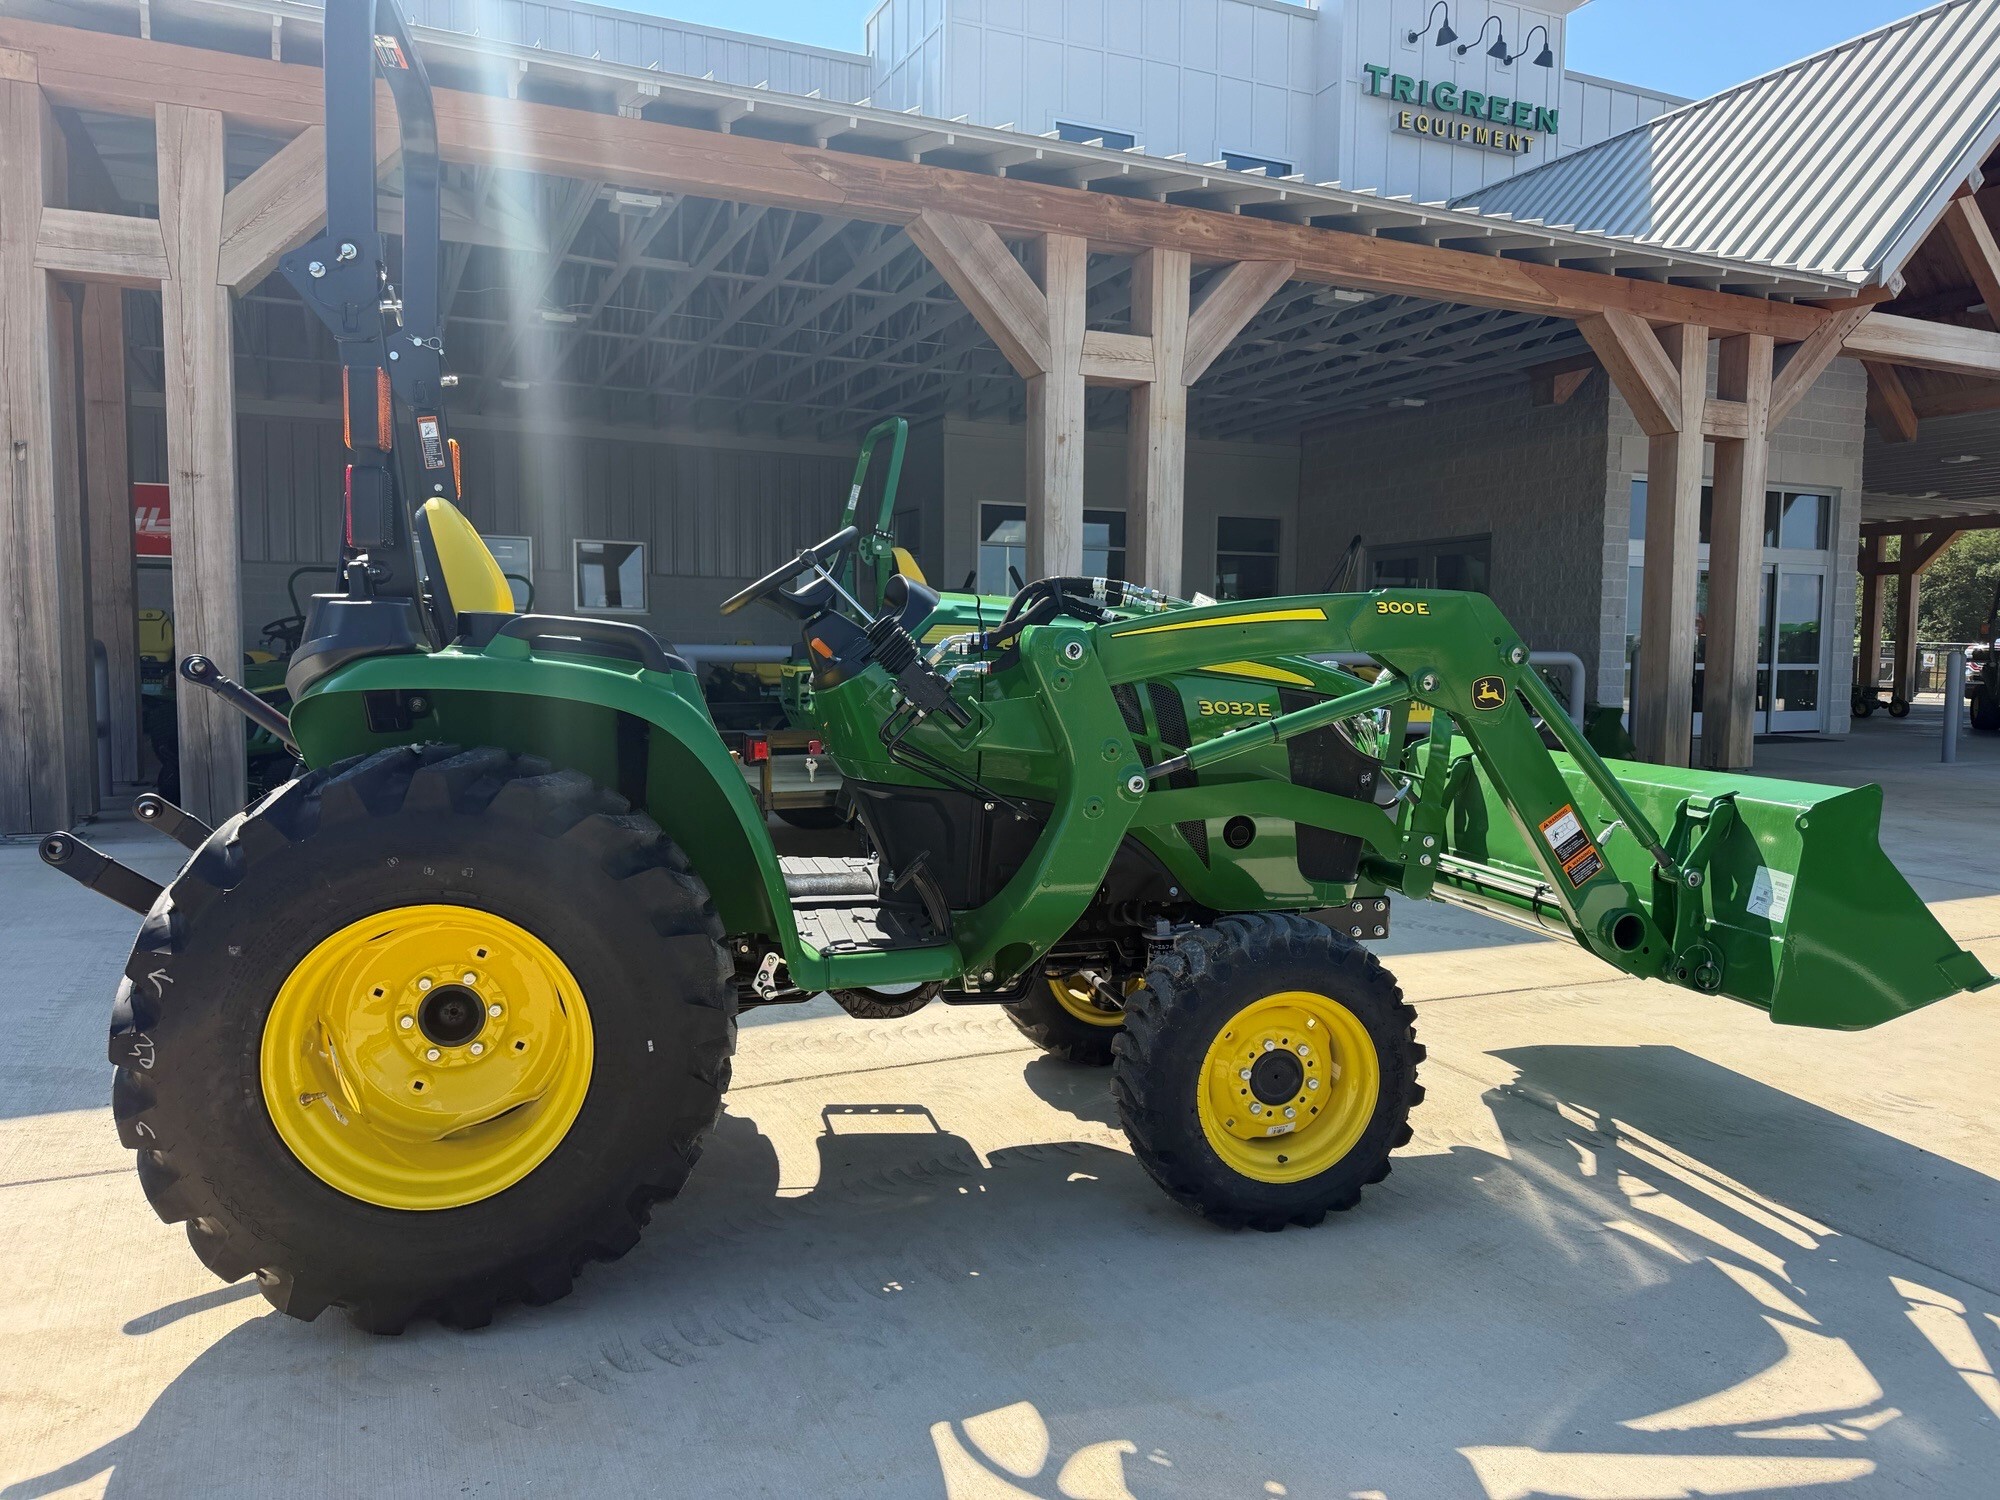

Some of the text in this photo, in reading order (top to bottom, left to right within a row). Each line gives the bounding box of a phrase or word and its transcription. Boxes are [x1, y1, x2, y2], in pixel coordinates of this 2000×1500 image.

[1363, 62, 1559, 135] TRIGREEN
[1398, 111, 1534, 153] EQUIPMENT
[1198, 700, 1272, 717] 3032E
